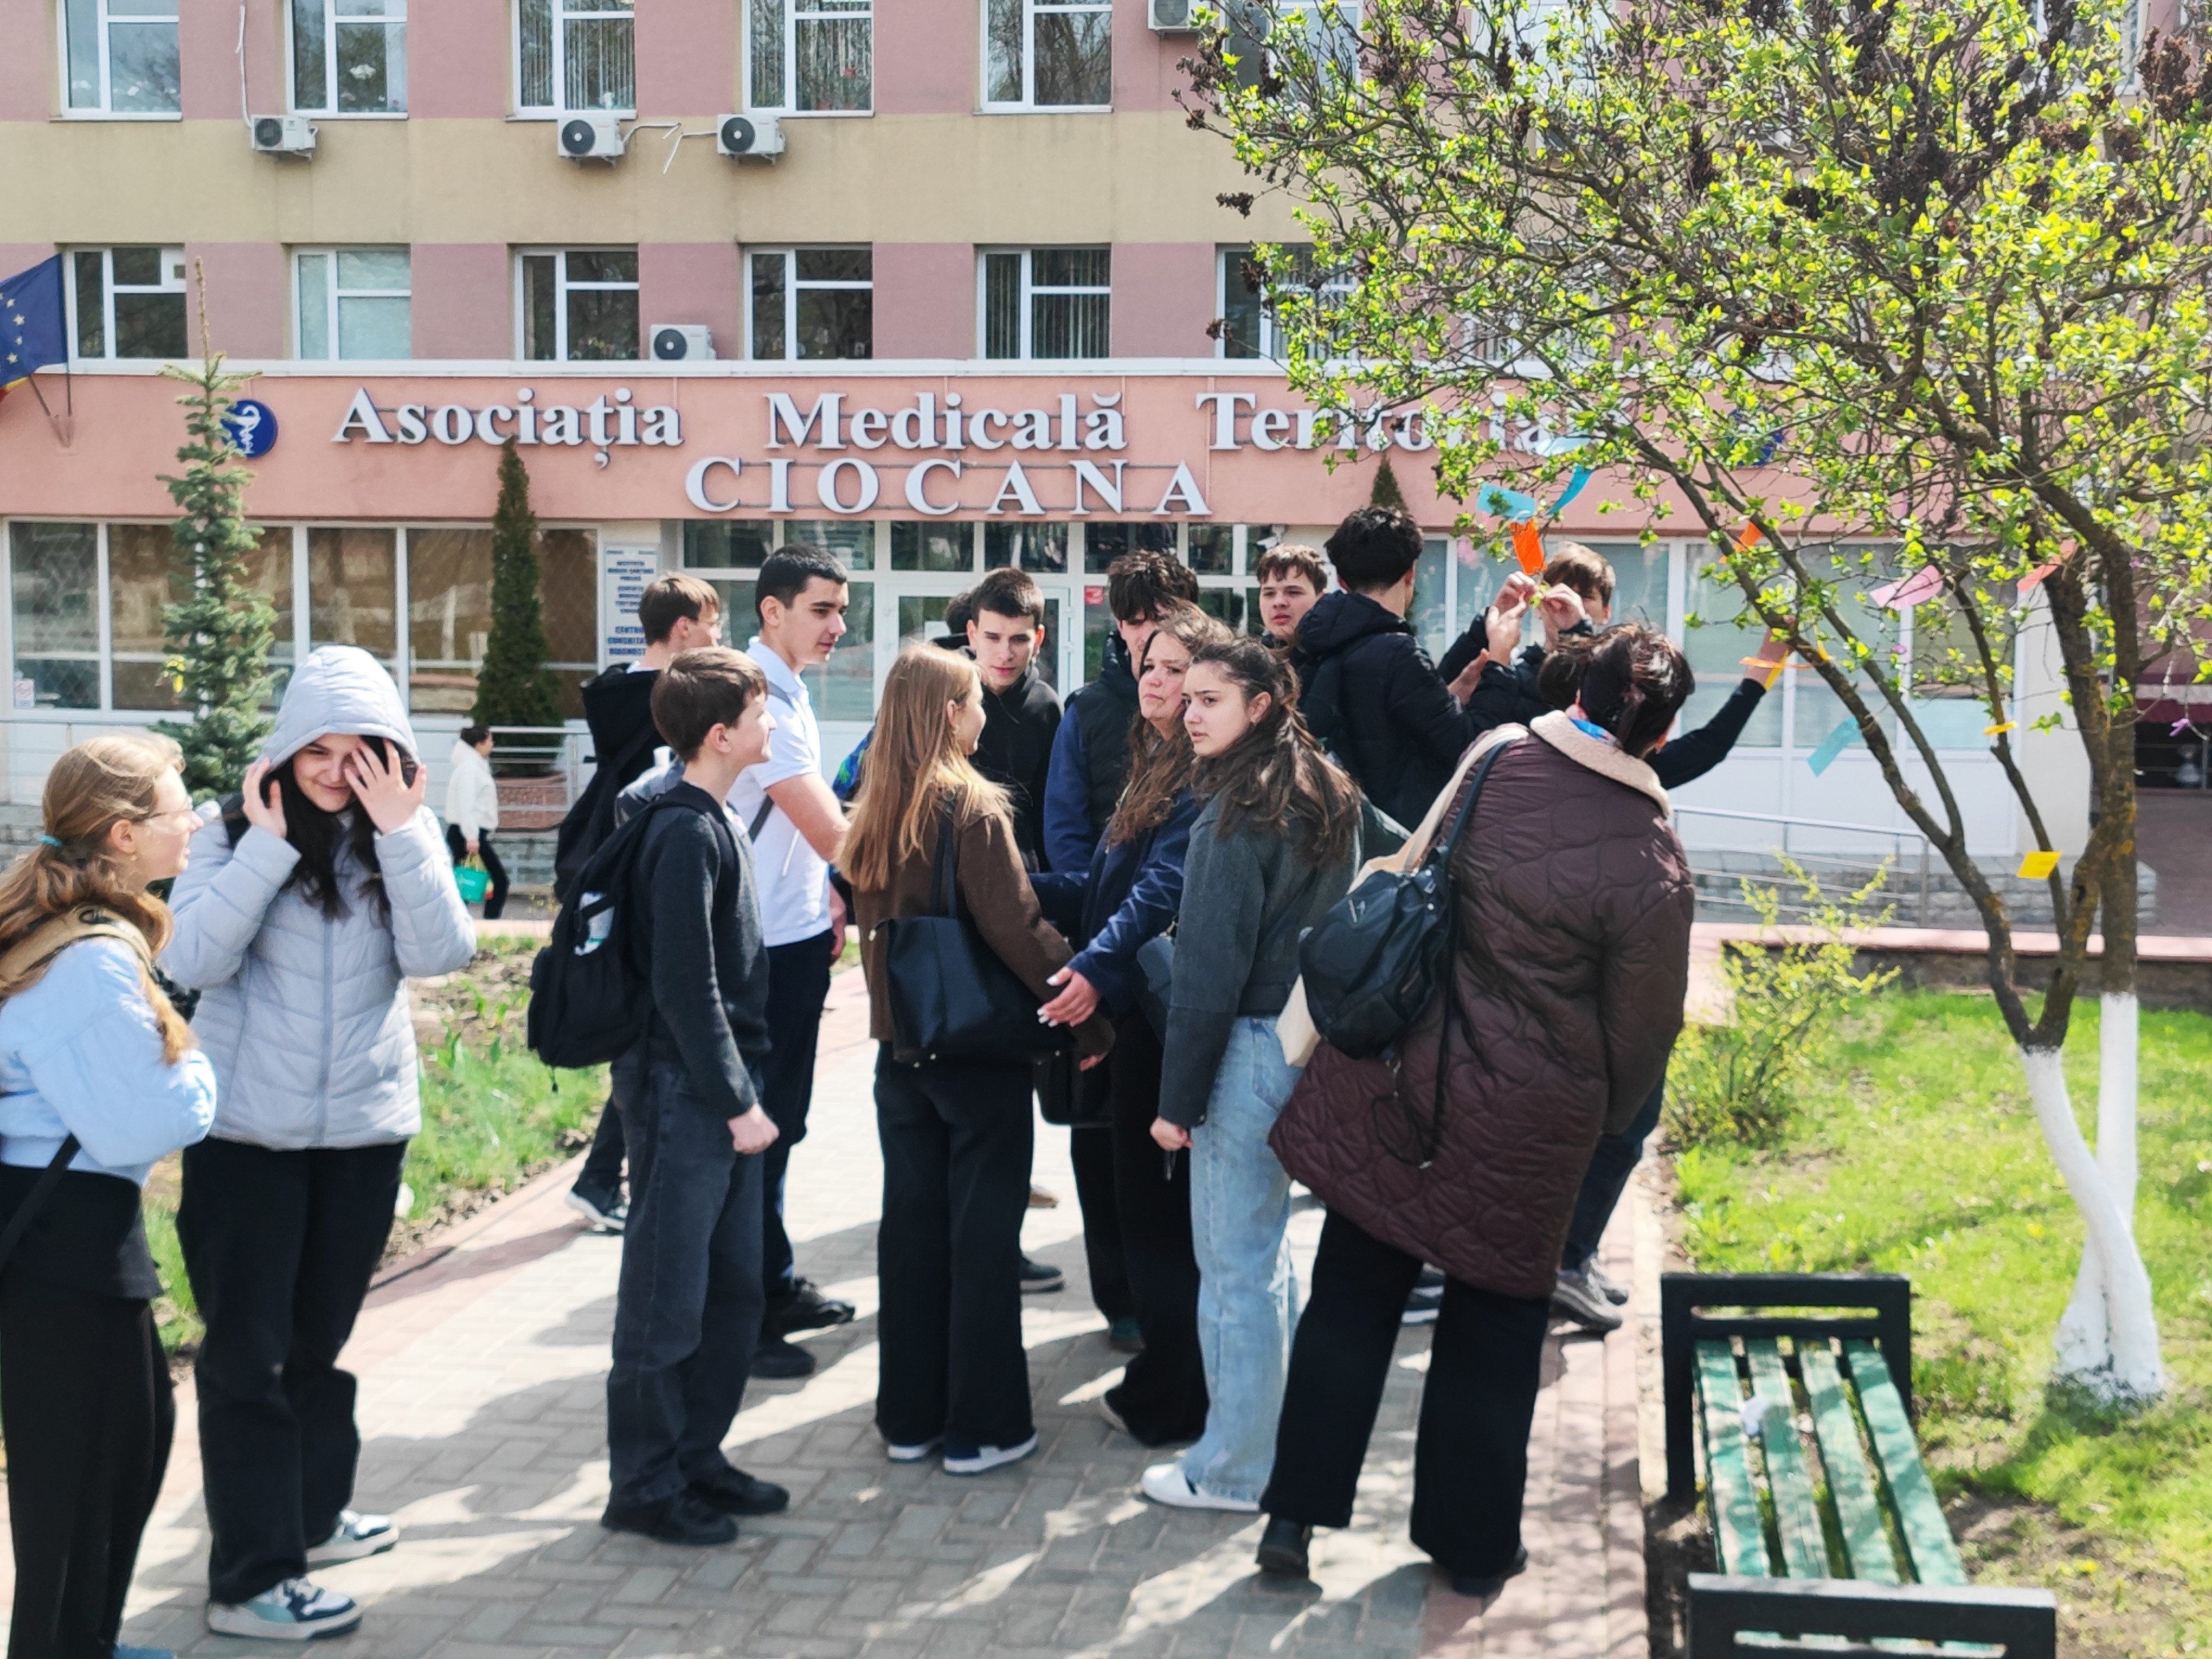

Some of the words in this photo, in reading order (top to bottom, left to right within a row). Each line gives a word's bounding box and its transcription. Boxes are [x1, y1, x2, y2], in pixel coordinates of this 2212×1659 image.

[331, 387, 685, 468] Asociația
[763, 391, 1128, 451] Medicală
[685, 456, 1212, 517] CIOCANA
